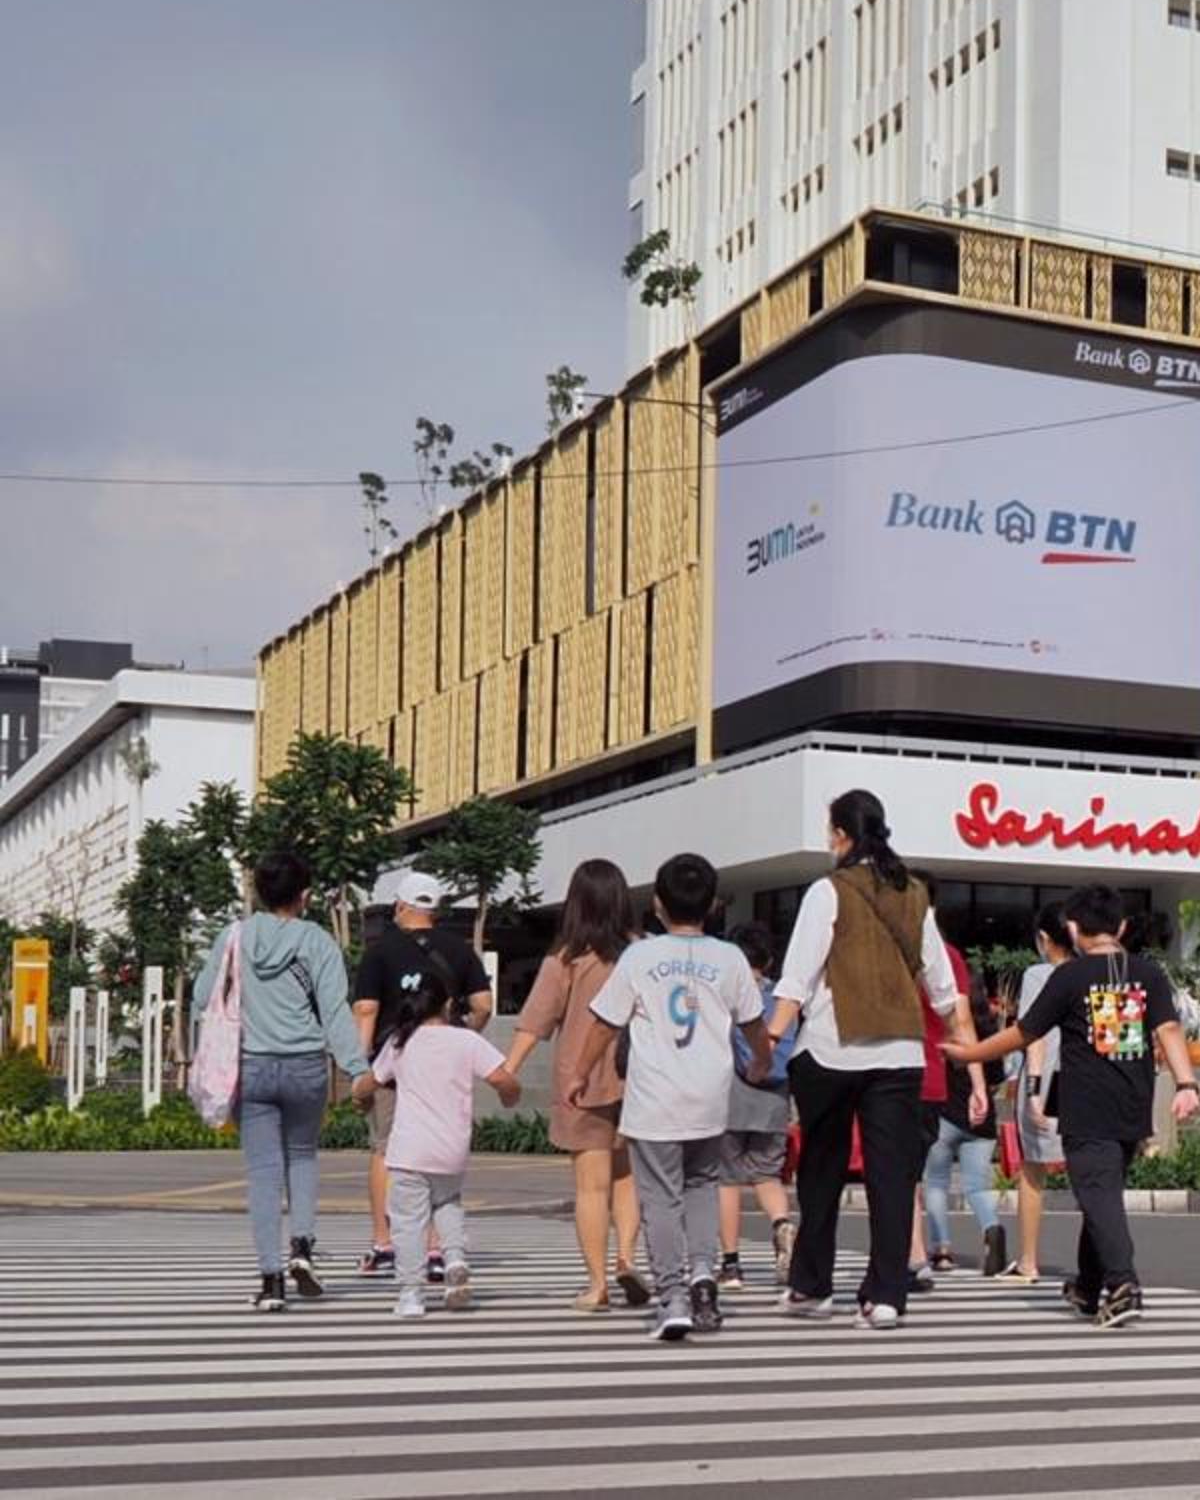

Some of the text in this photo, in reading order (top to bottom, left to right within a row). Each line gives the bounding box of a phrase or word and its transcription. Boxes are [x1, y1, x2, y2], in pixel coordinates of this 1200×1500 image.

[1075, 341, 1124, 369] Bank
[885, 491, 1136, 553] Bank BTN
[647, 959, 720, 983] TORRES
[669, 984, 698, 1049] 9
